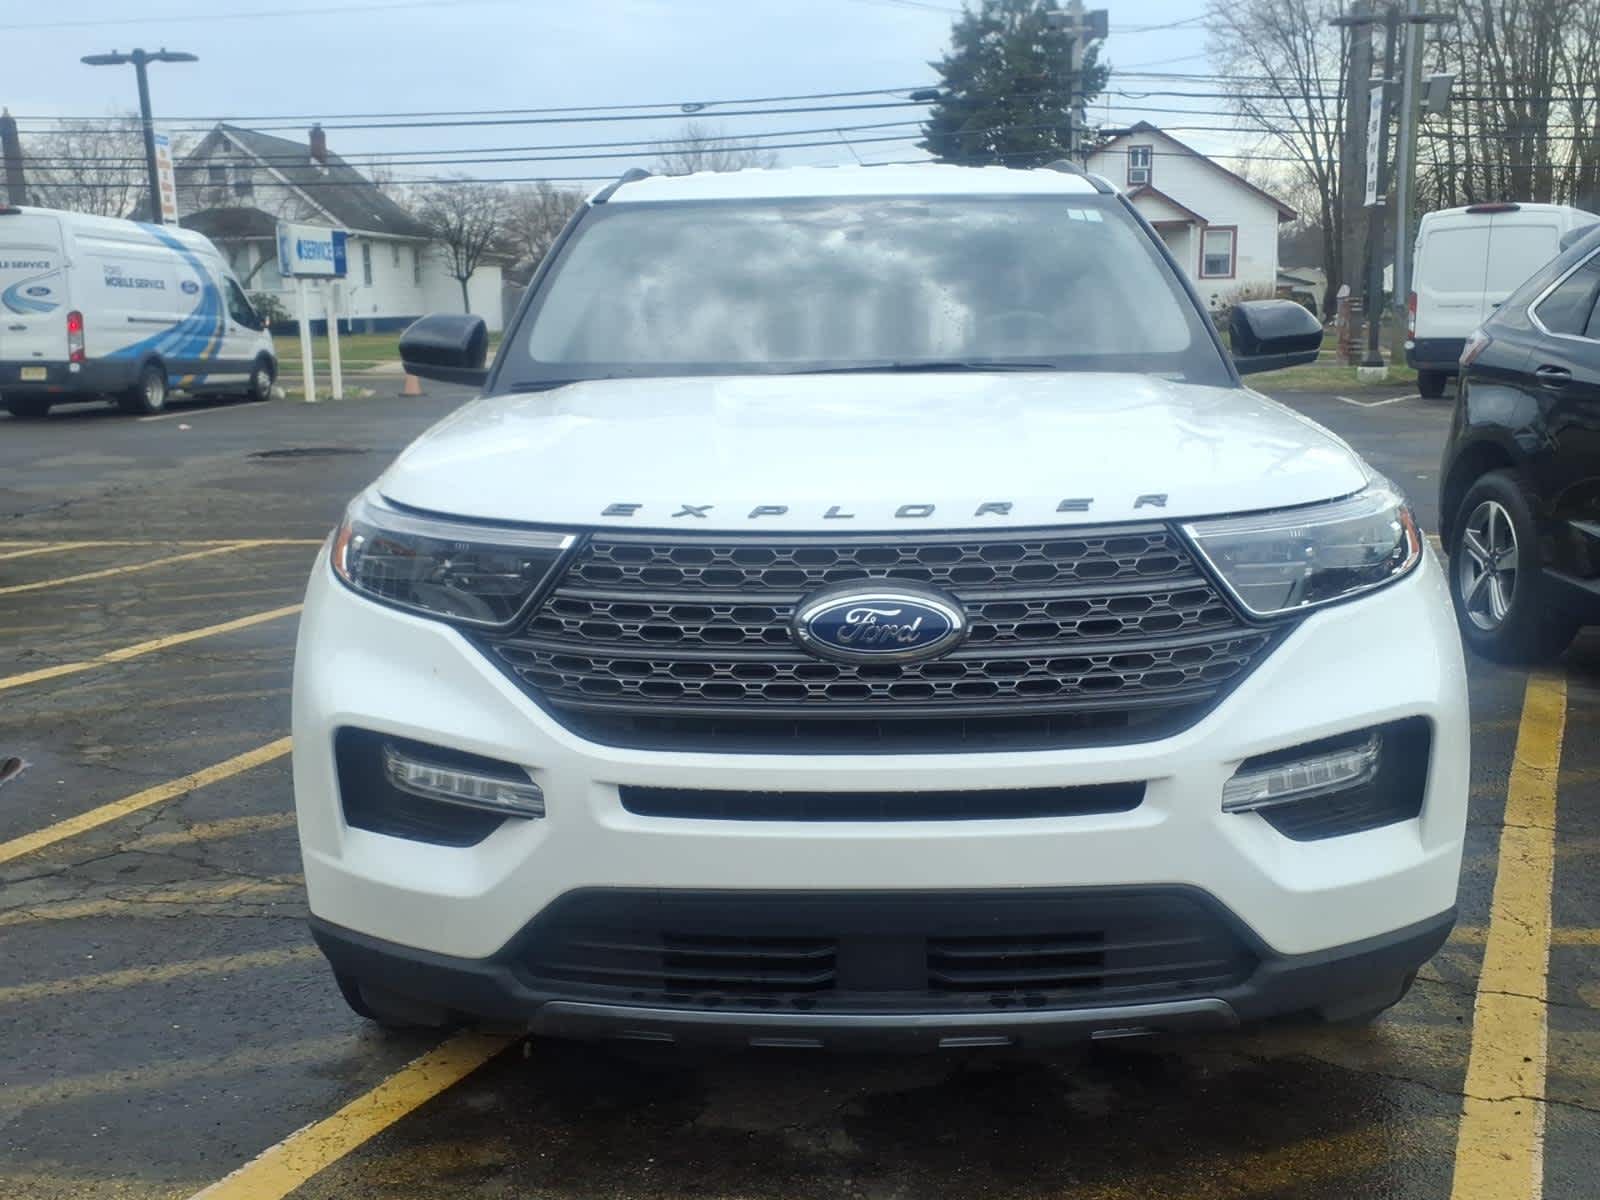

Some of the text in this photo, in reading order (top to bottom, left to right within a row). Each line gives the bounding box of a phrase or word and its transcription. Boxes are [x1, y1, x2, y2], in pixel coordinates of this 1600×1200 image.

[303, 240, 333, 261] SERVICE
[12, 261, 50, 269] SERVICE
[104, 277, 166, 290] MOBILE SERVICE
[601, 493, 1168, 519] EXPLORER
[837, 607, 922, 643] Ford
